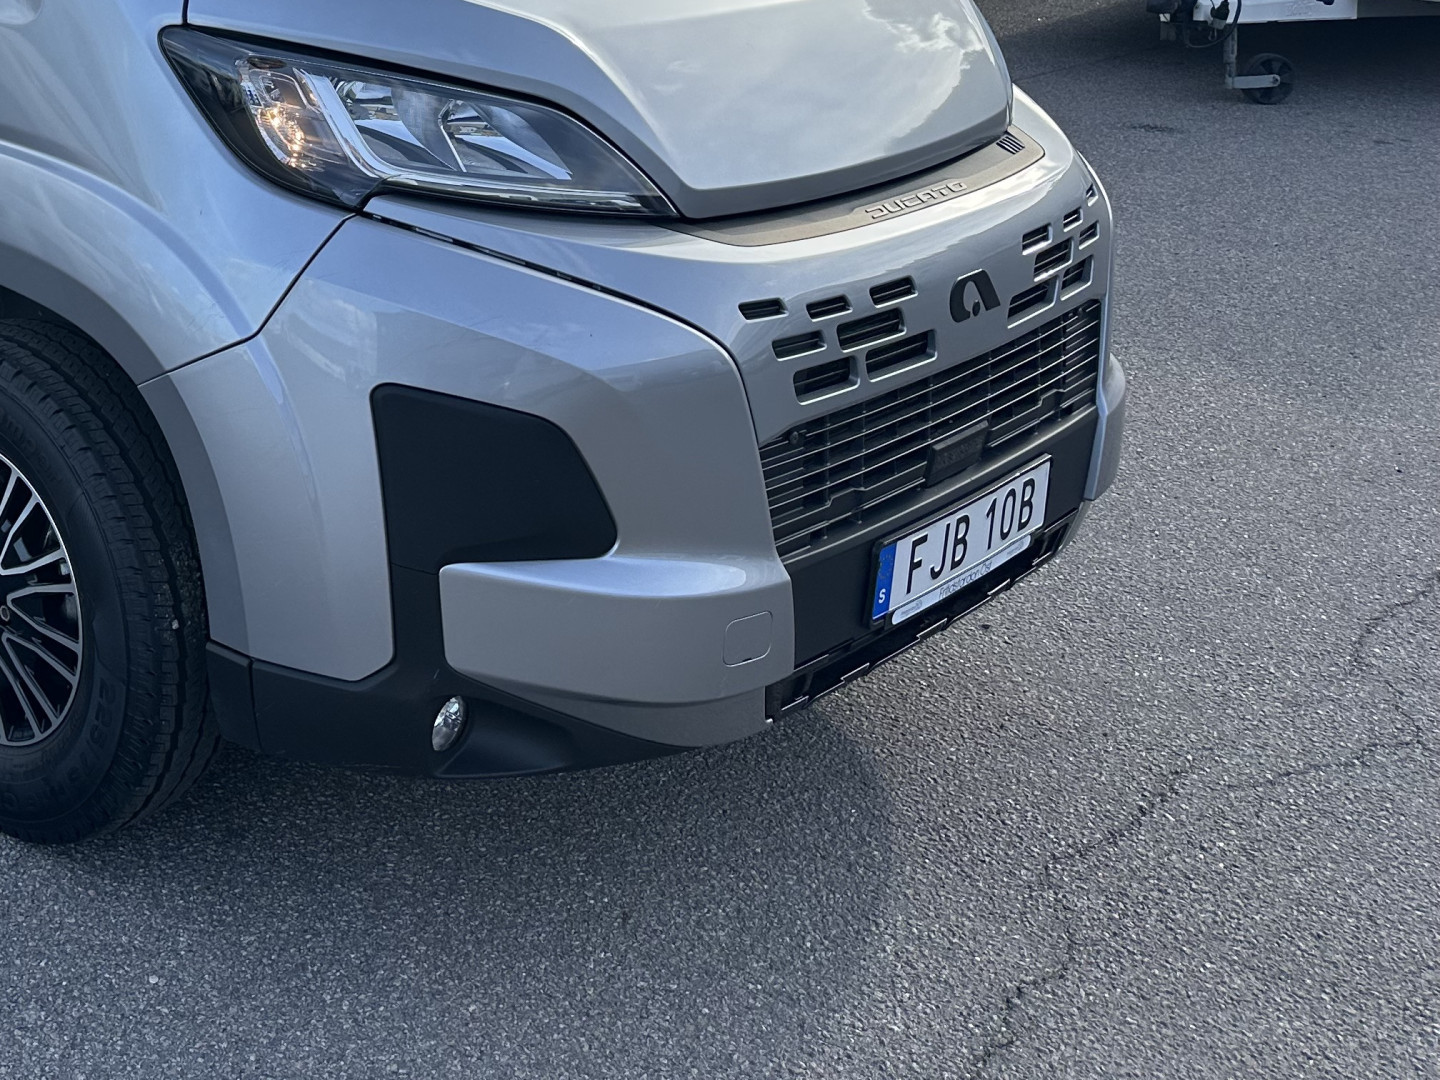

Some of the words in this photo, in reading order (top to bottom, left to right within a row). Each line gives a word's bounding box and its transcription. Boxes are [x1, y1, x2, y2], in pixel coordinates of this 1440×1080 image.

[865, 181, 968, 219] DUCATO
[906, 514, 970, 595] FJB
[986, 478, 1036, 550] 10B
[878, 588, 886, 603] S
